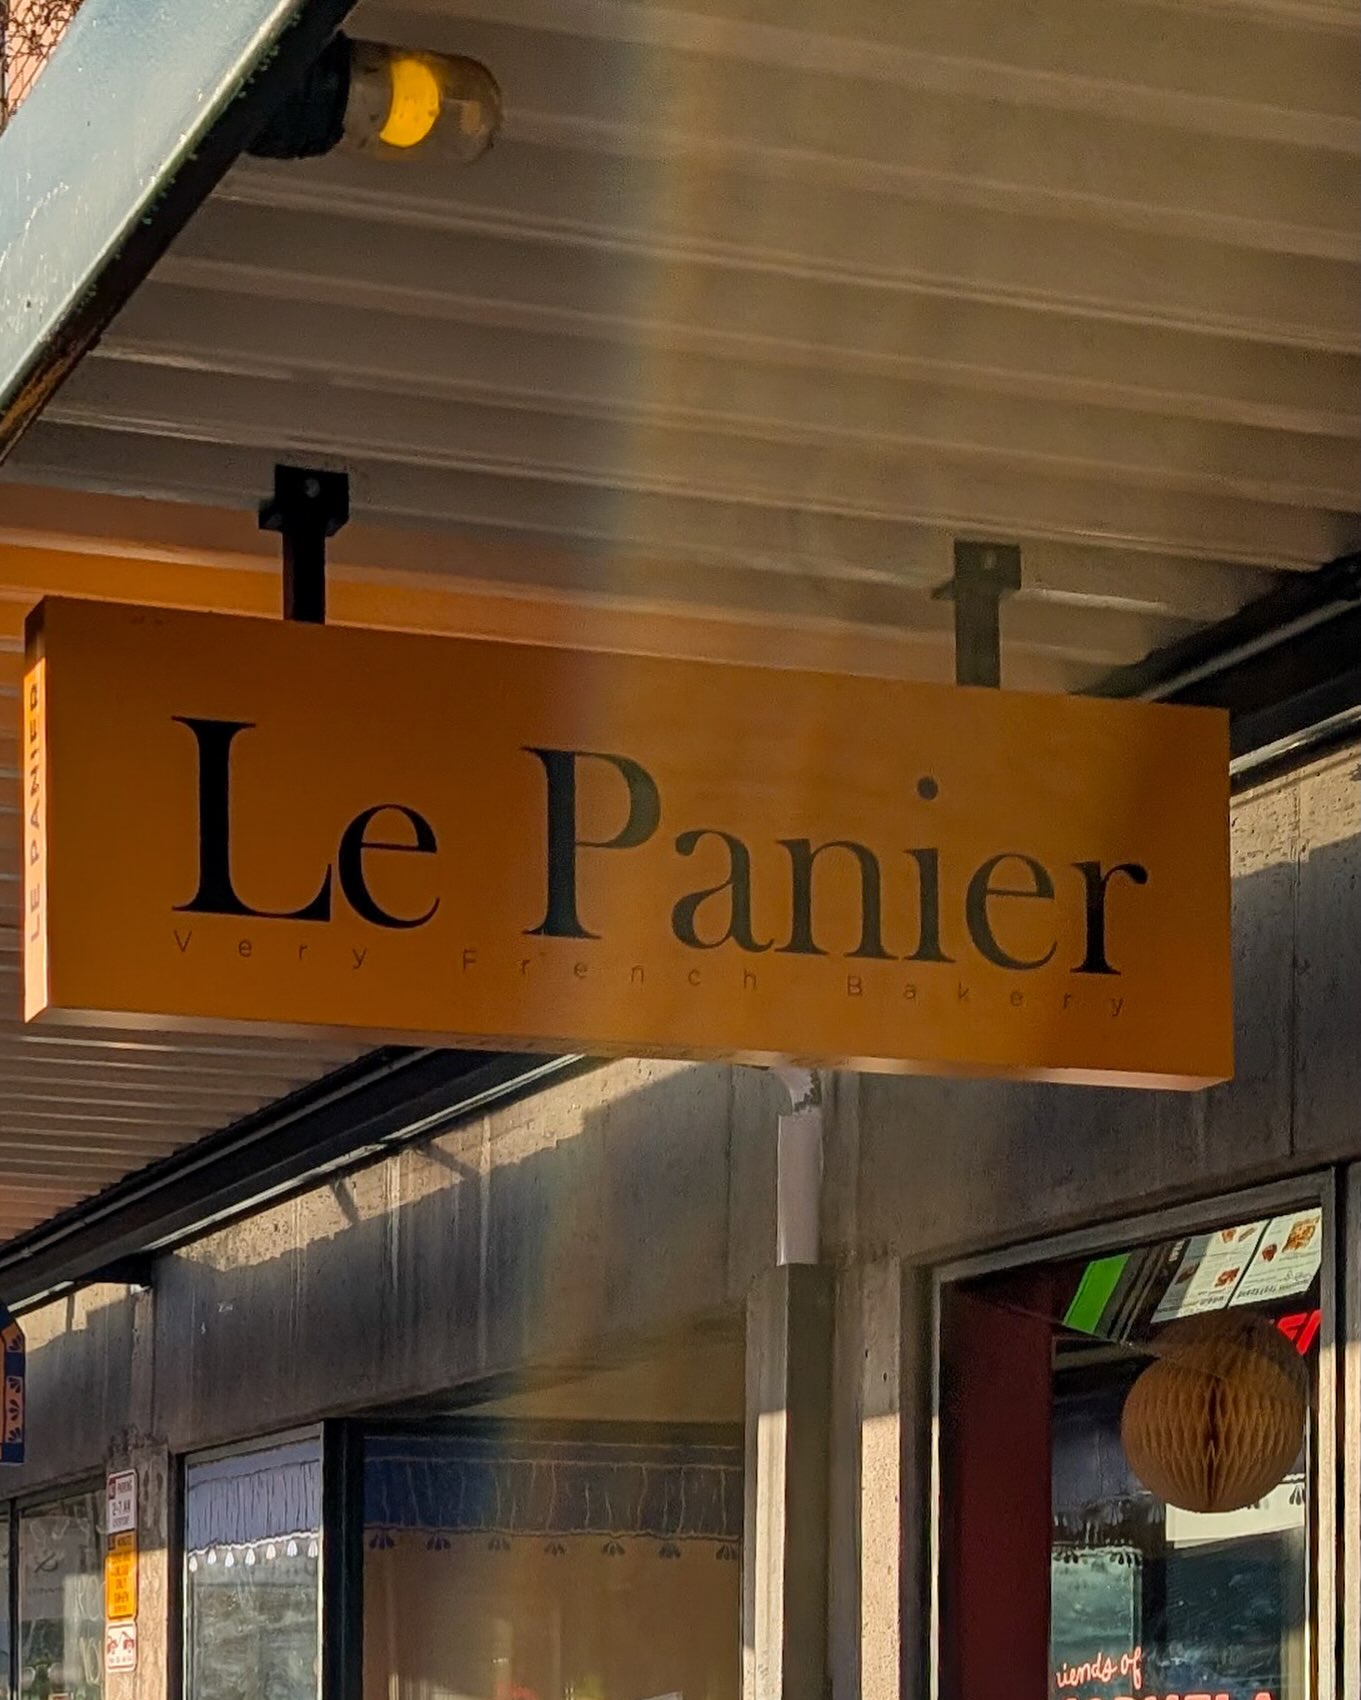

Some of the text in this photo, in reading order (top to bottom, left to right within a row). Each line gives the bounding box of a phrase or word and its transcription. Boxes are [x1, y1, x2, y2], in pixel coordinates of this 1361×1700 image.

[170, 714, 1149, 976] Le Panier
[29, 888, 40, 942] LE
[171, 927, 1126, 1019] Very French Bakery
[1121, 1645, 1142, 1690] of
